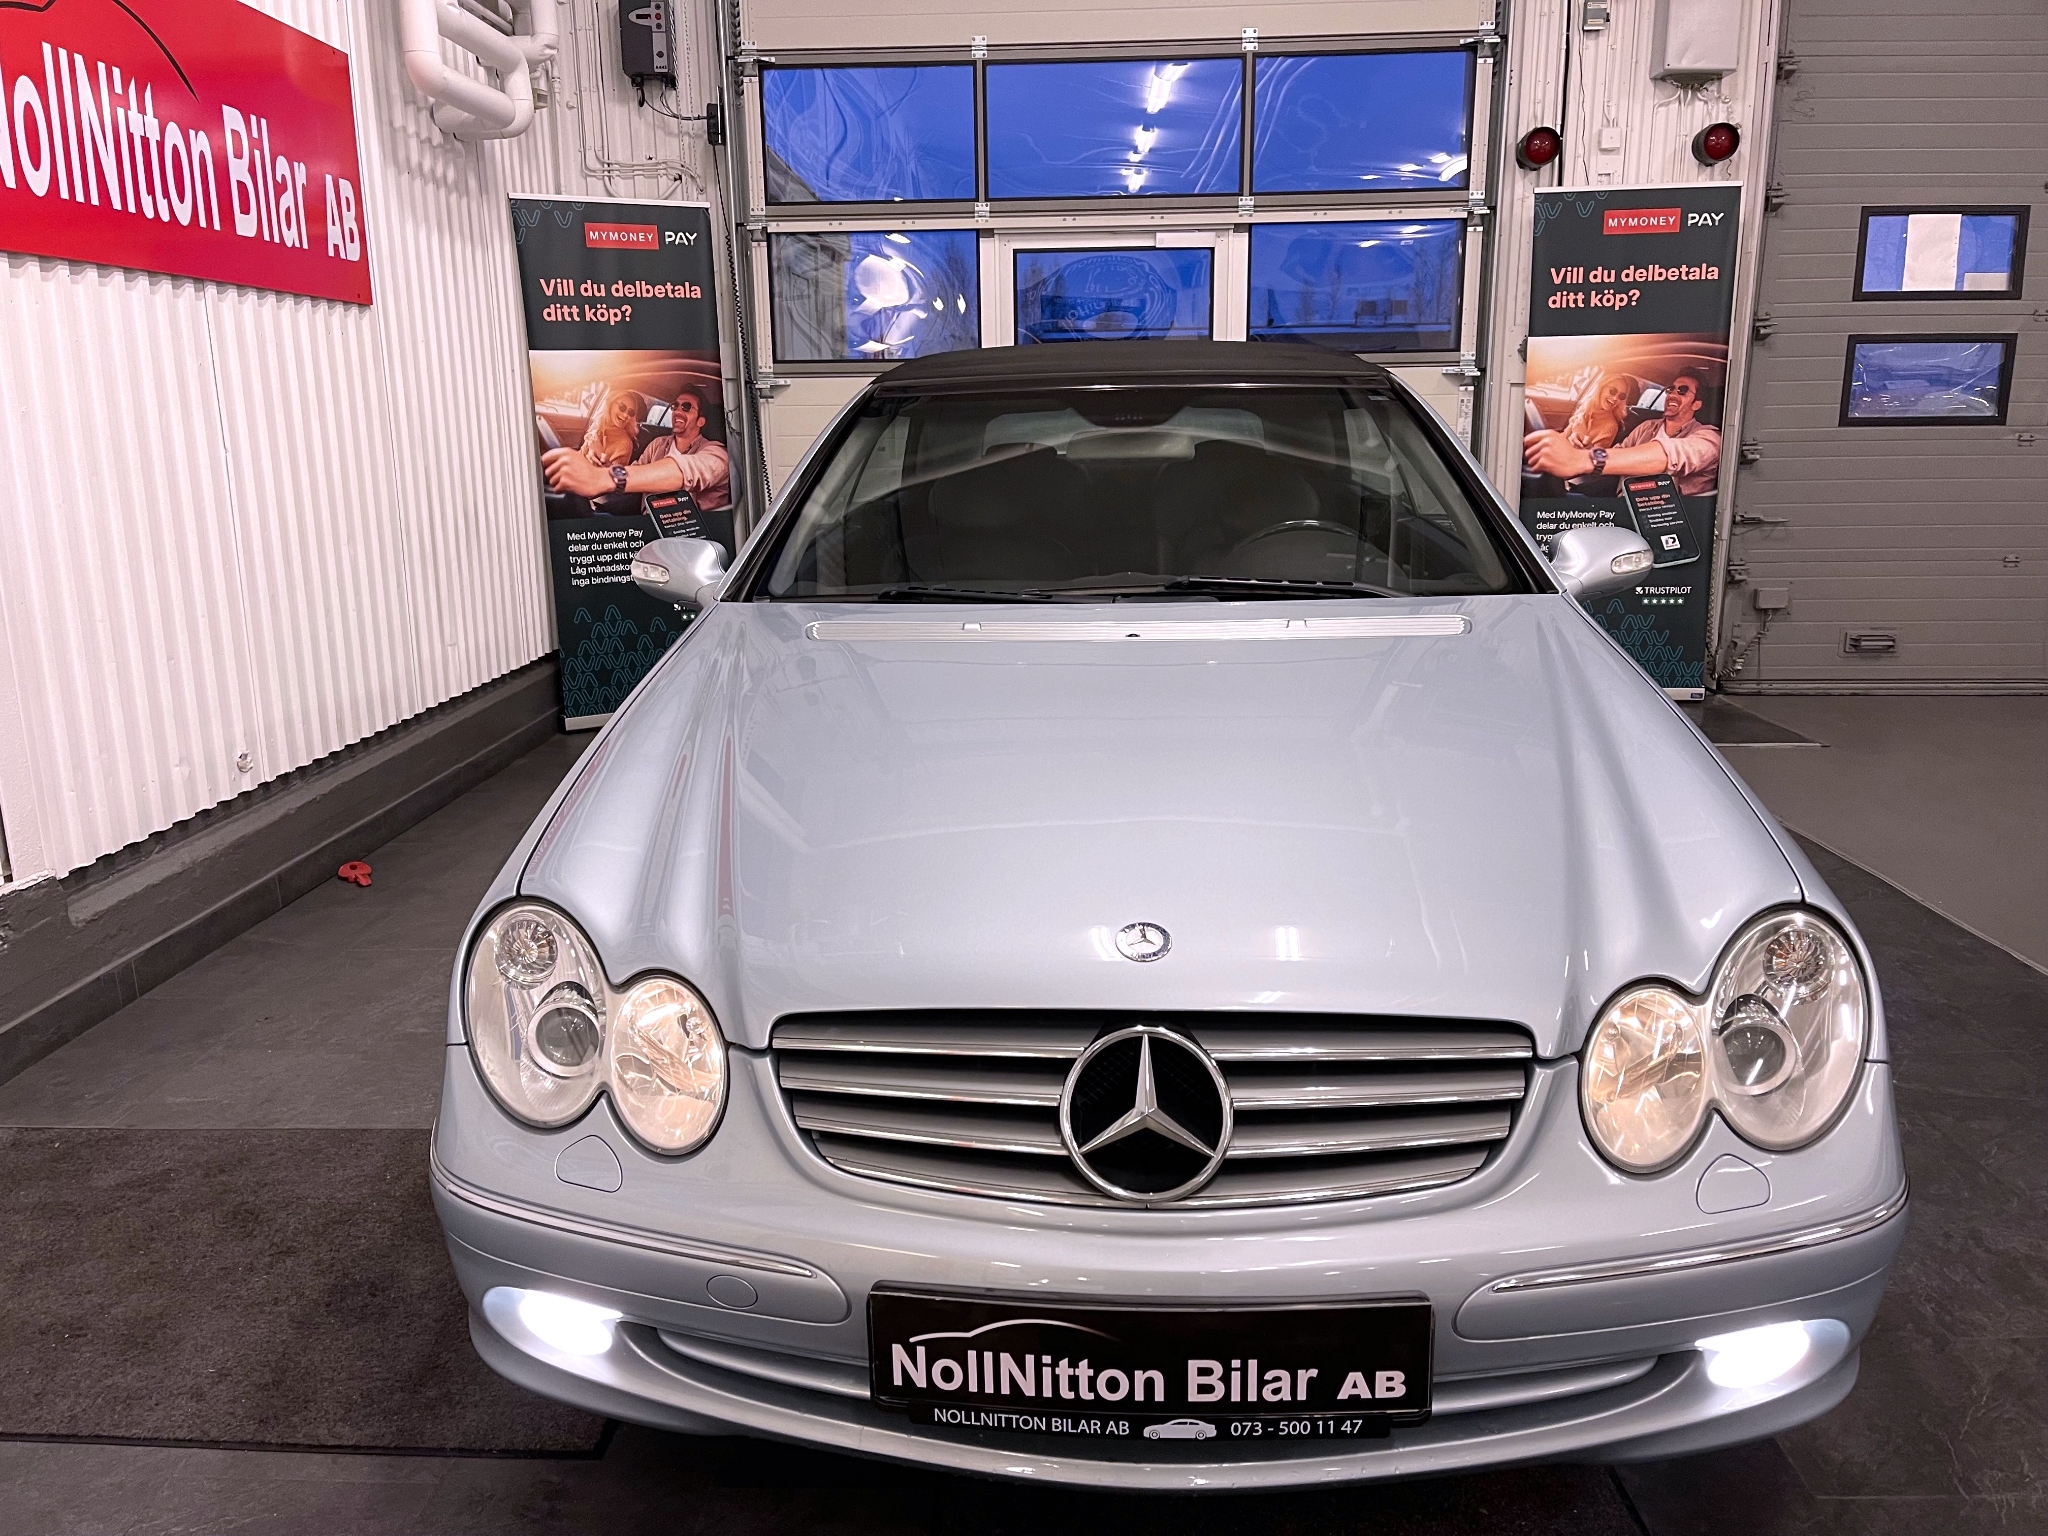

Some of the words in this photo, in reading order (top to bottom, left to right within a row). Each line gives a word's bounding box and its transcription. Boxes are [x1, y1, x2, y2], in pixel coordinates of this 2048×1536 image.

[222, 104, 308, 250] Bilar
[325, 173, 360, 261] AB
[1608, 216, 1676, 227] MYMONEY
[1687, 212, 1724, 227] PAY
[590, 230, 654, 242] MYMONEY
[664, 231, 697, 245] PAY
[1550, 266, 1584, 285] Vill
[1589, 266, 1616, 283] du
[1621, 263, 1719, 282] delbetala
[539, 278, 574, 297] Vill
[580, 279, 605, 297] du
[611, 280, 702, 299] delbetala
[1548, 291, 1584, 309] ditt
[1590, 289, 1640, 310] köp?
[542, 304, 580, 322] ditt
[585, 304, 632, 325] köp?
[1536, 510, 1556, 519] Med
[1557, 510, 1598, 520] MyMoney
[1599, 510, 1616, 520] Pay
[1536, 521, 1558, 530] delar
[1558, 521, 1571, 530] du
[566, 532, 586, 541] Med
[587, 530, 627, 540] MyMoney
[628, 528, 644, 538] Pay
[568, 543, 590, 552] delar
[591, 542, 602, 551] du
[603, 540, 629, 549] enkelt
[629, 539, 645, 548] och
[569, 554, 596, 565] tryggt
[596, 554, 613, 563] upp
[613, 551, 628, 560] ditt
[570, 566, 587, 576] Låg
[1645, 586, 1692, 595] TRUSTPILOT
[892, 1343, 1165, 1402] NollNitton
[1187, 1359, 1319, 1402] Bilar
[1336, 1370, 1407, 1400] AB
[934, 1408, 1046, 1431] NOLLNITTON
[1052, 1418, 1101, 1434] BILAR
[1105, 1420, 1130, 1436] AB
[1230, 1422, 1262, 1436] 073
[1279, 1421, 1311, 1435] 500
[1317, 1420, 1335, 1434] 11
[1341, 1419, 1363, 1434] 47
